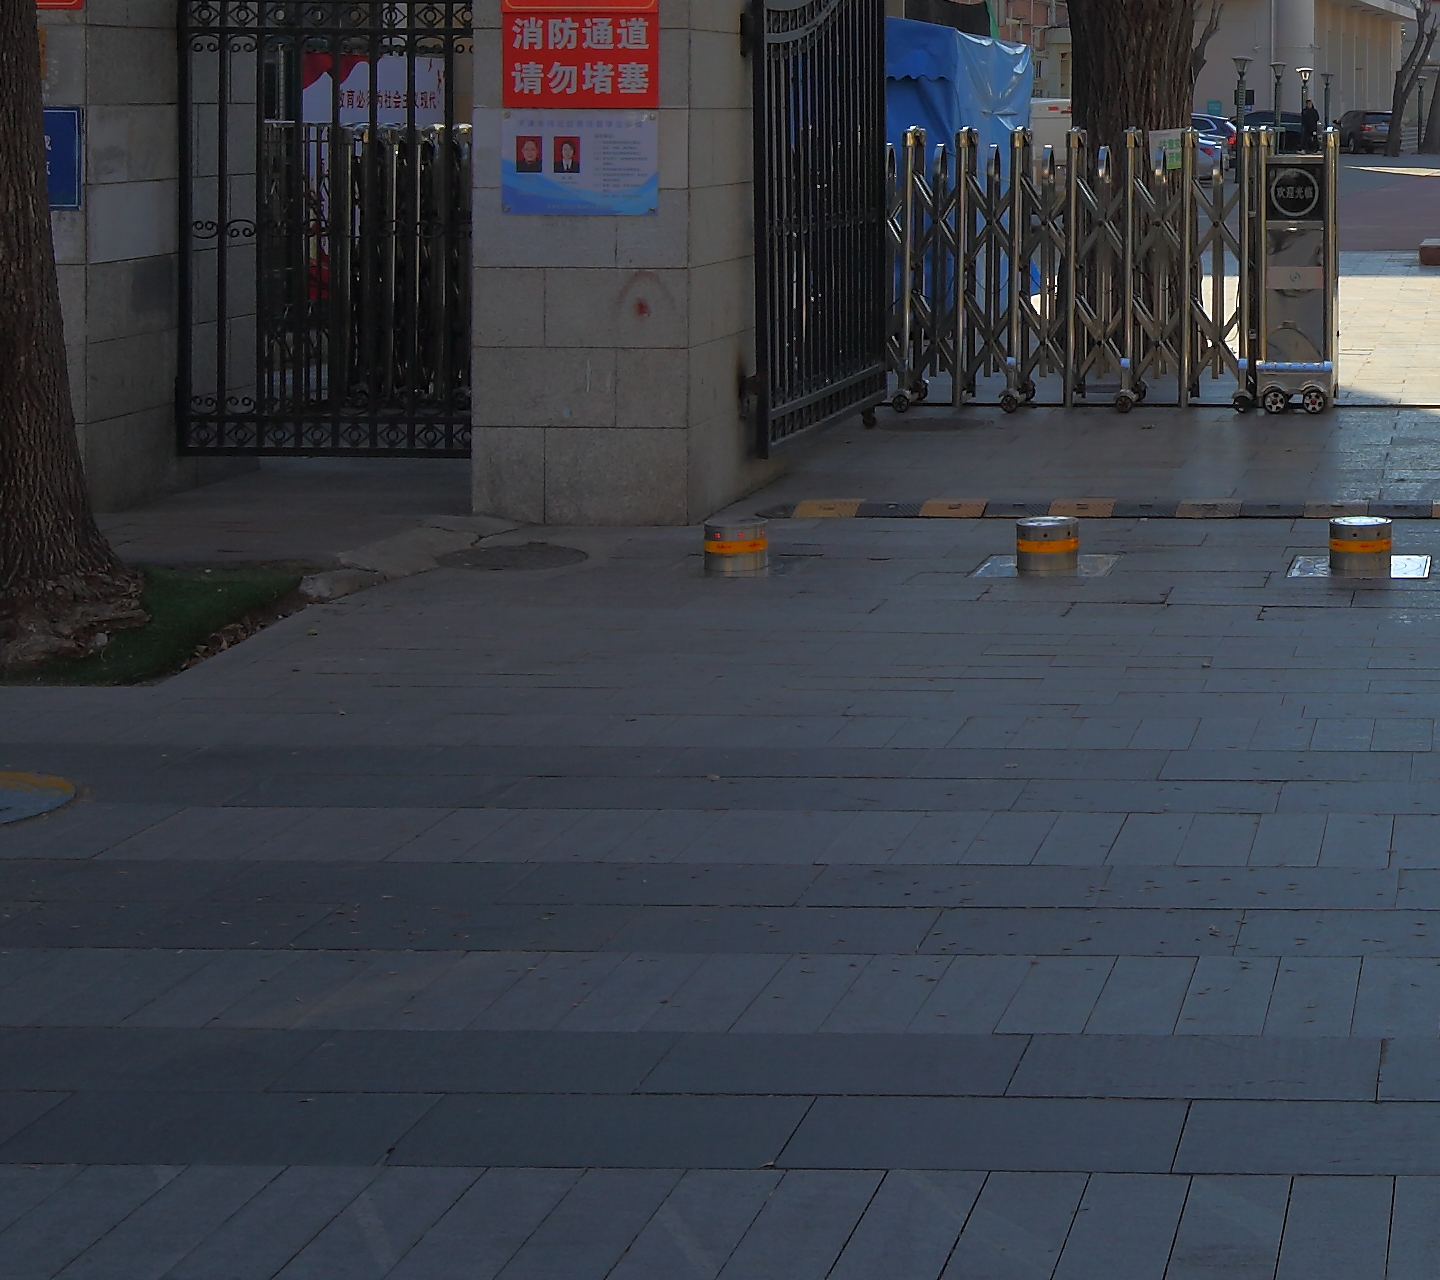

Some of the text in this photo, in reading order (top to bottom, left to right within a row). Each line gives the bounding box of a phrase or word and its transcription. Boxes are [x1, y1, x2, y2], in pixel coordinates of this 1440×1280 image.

[512, 17, 650, 50] 消防通道
[511, 62, 650, 95] 请勿堵塞
[1276, 186, 1313, 199] 欢迎光临
